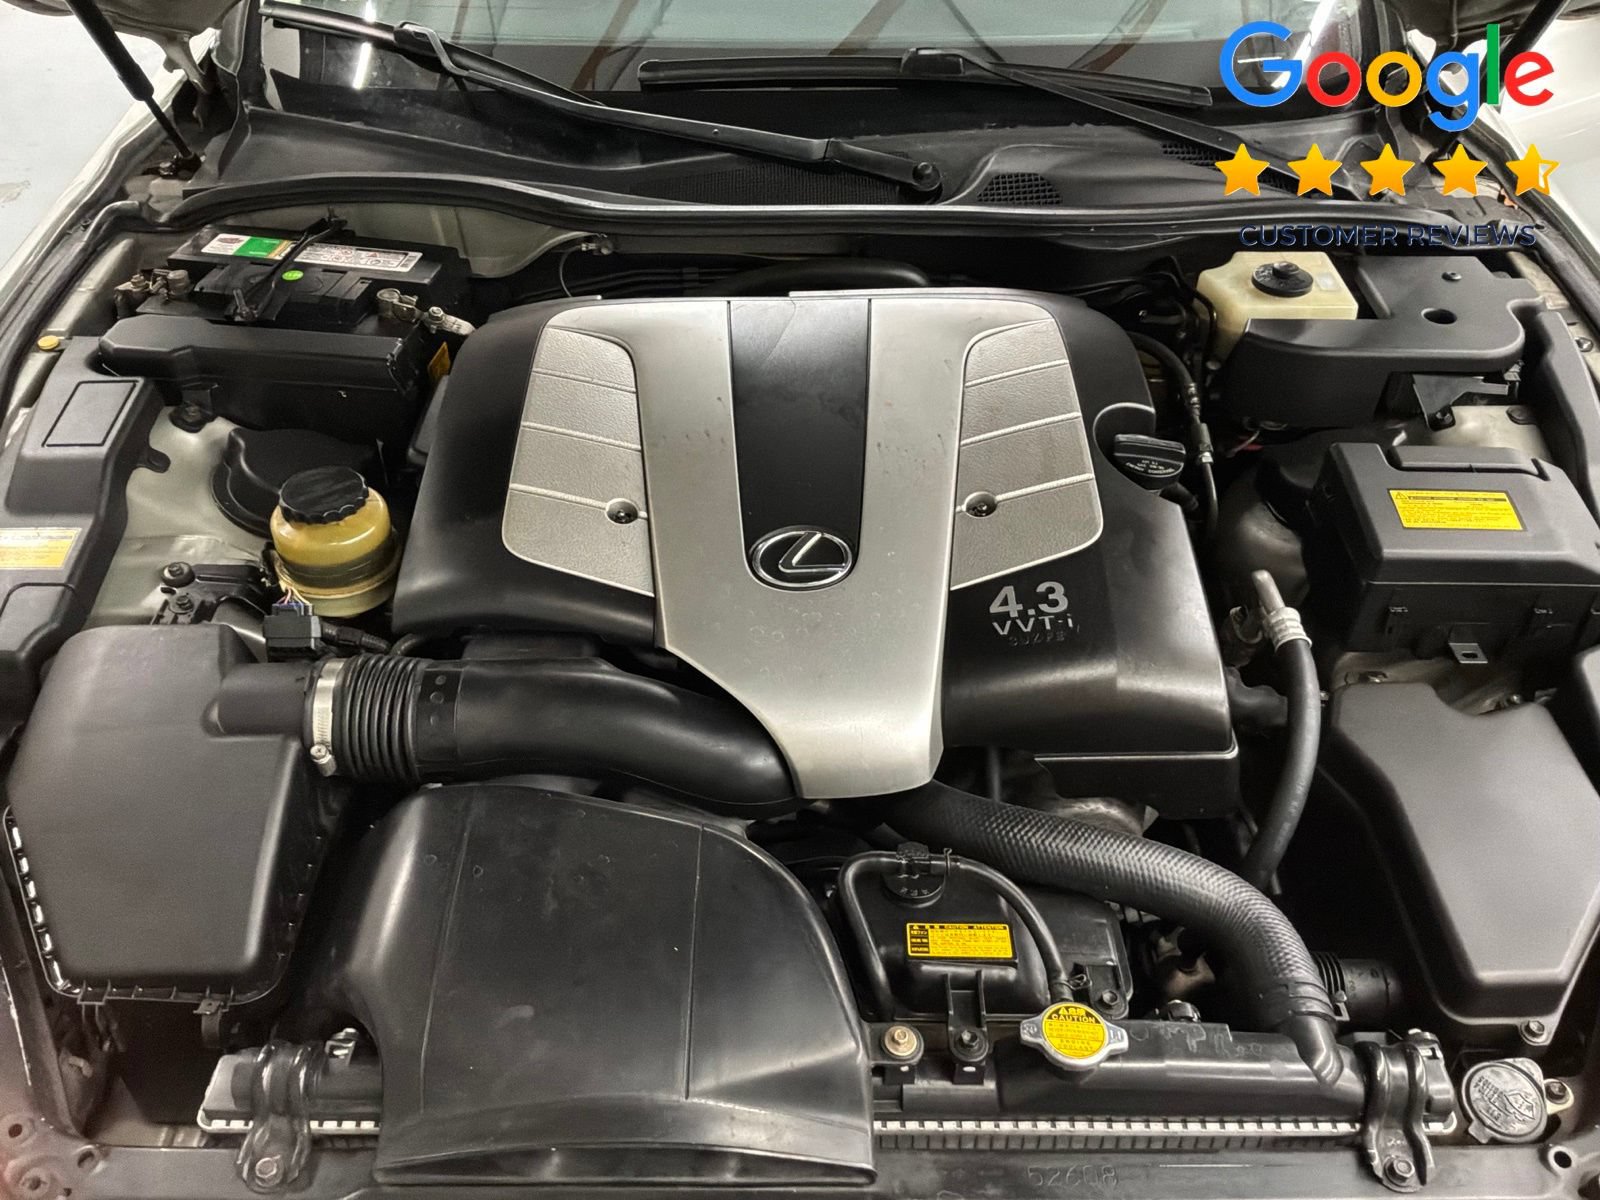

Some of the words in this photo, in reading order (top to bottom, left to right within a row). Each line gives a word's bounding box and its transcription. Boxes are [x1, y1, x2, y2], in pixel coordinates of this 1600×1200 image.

[989, 581, 1068, 617] 4.3
[992, 613, 1073, 636] VVT-i
[1051, 1014, 1096, 1024] CAUTION
